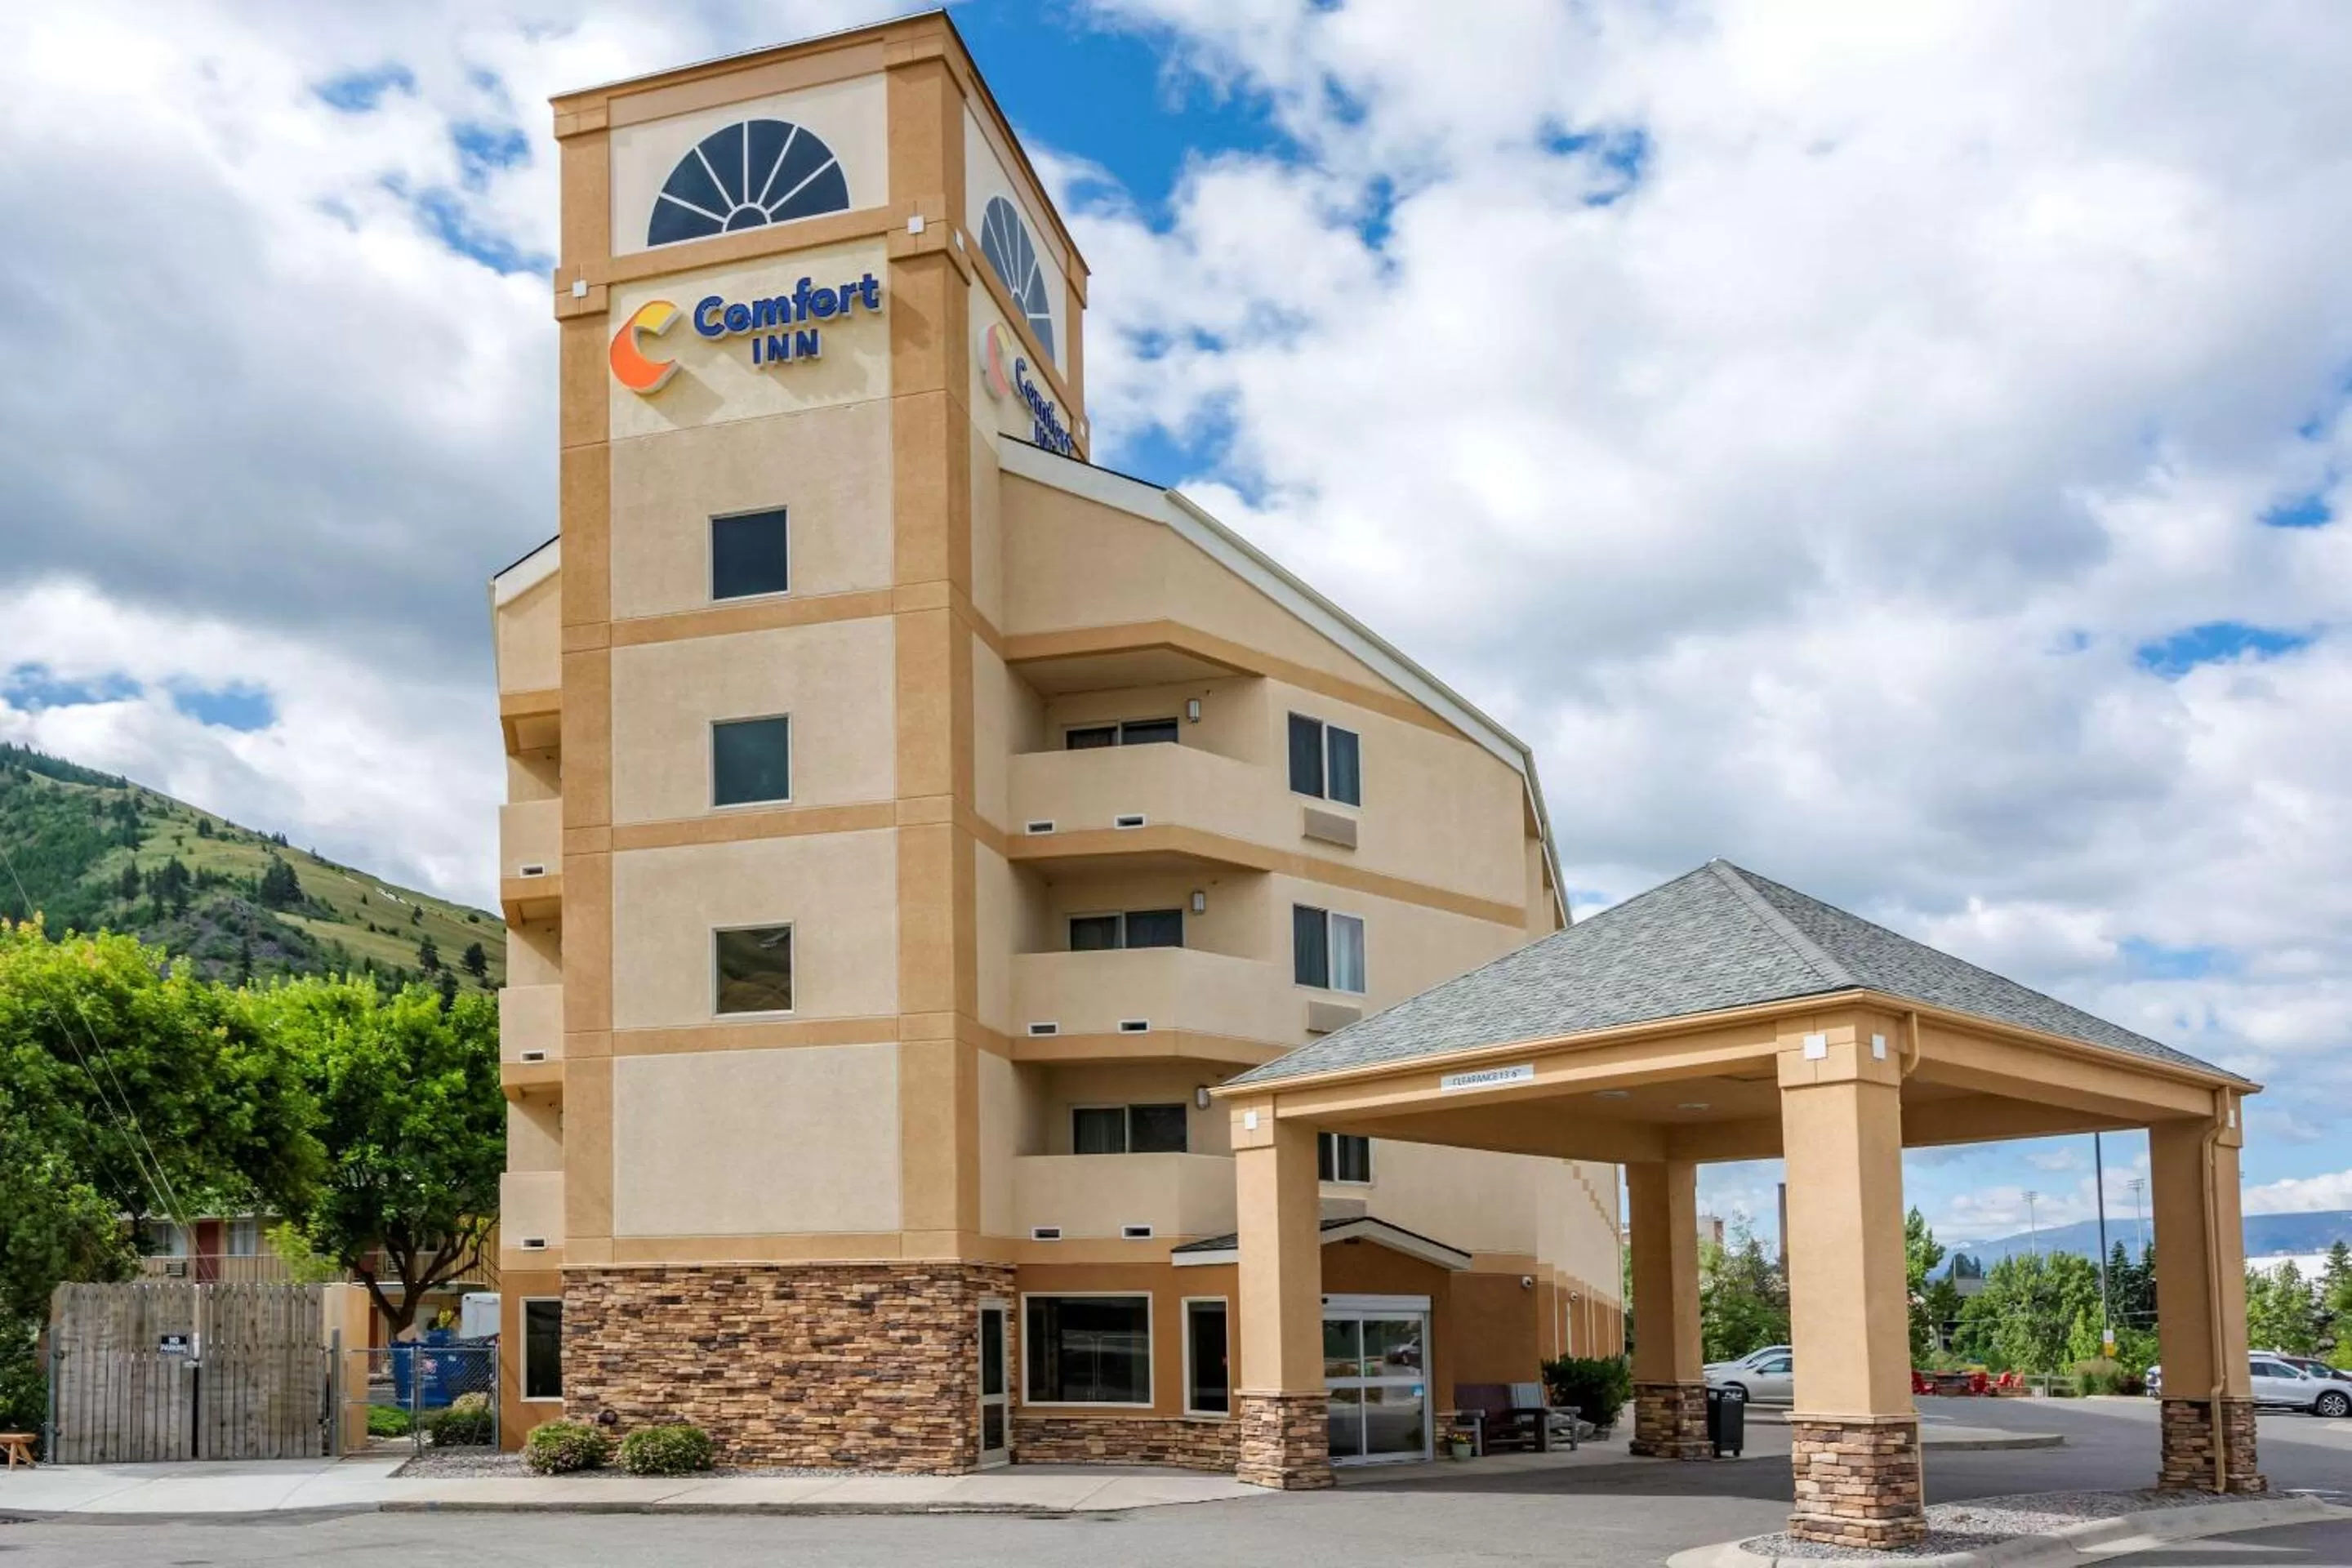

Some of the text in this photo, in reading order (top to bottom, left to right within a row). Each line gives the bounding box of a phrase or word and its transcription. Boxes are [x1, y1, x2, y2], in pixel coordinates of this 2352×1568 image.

[693, 273, 881, 338] Comfort
[752, 328, 821, 366] INN
[1453, 1071, 1498, 1085] CLEARANCE
